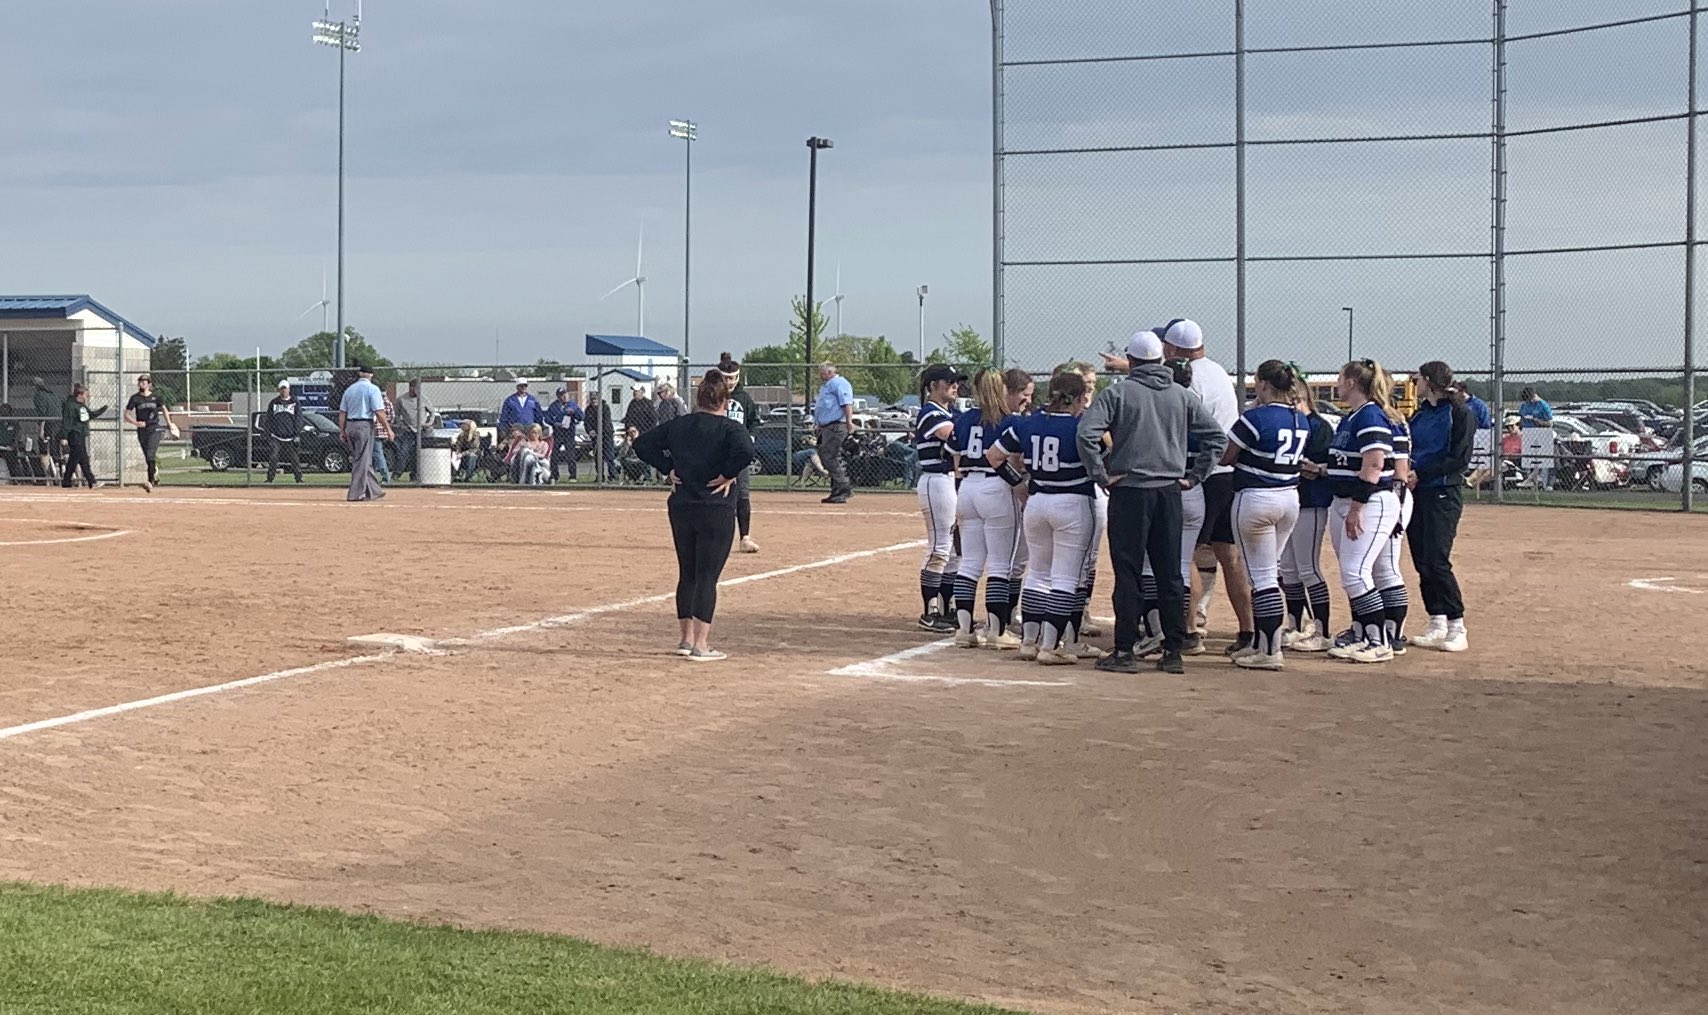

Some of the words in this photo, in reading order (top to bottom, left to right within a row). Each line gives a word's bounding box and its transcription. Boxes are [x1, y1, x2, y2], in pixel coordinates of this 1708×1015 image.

[967, 426, 984, 459] 6
[1031, 435, 1060, 472] 18
[1274, 428, 1309, 465] 27
